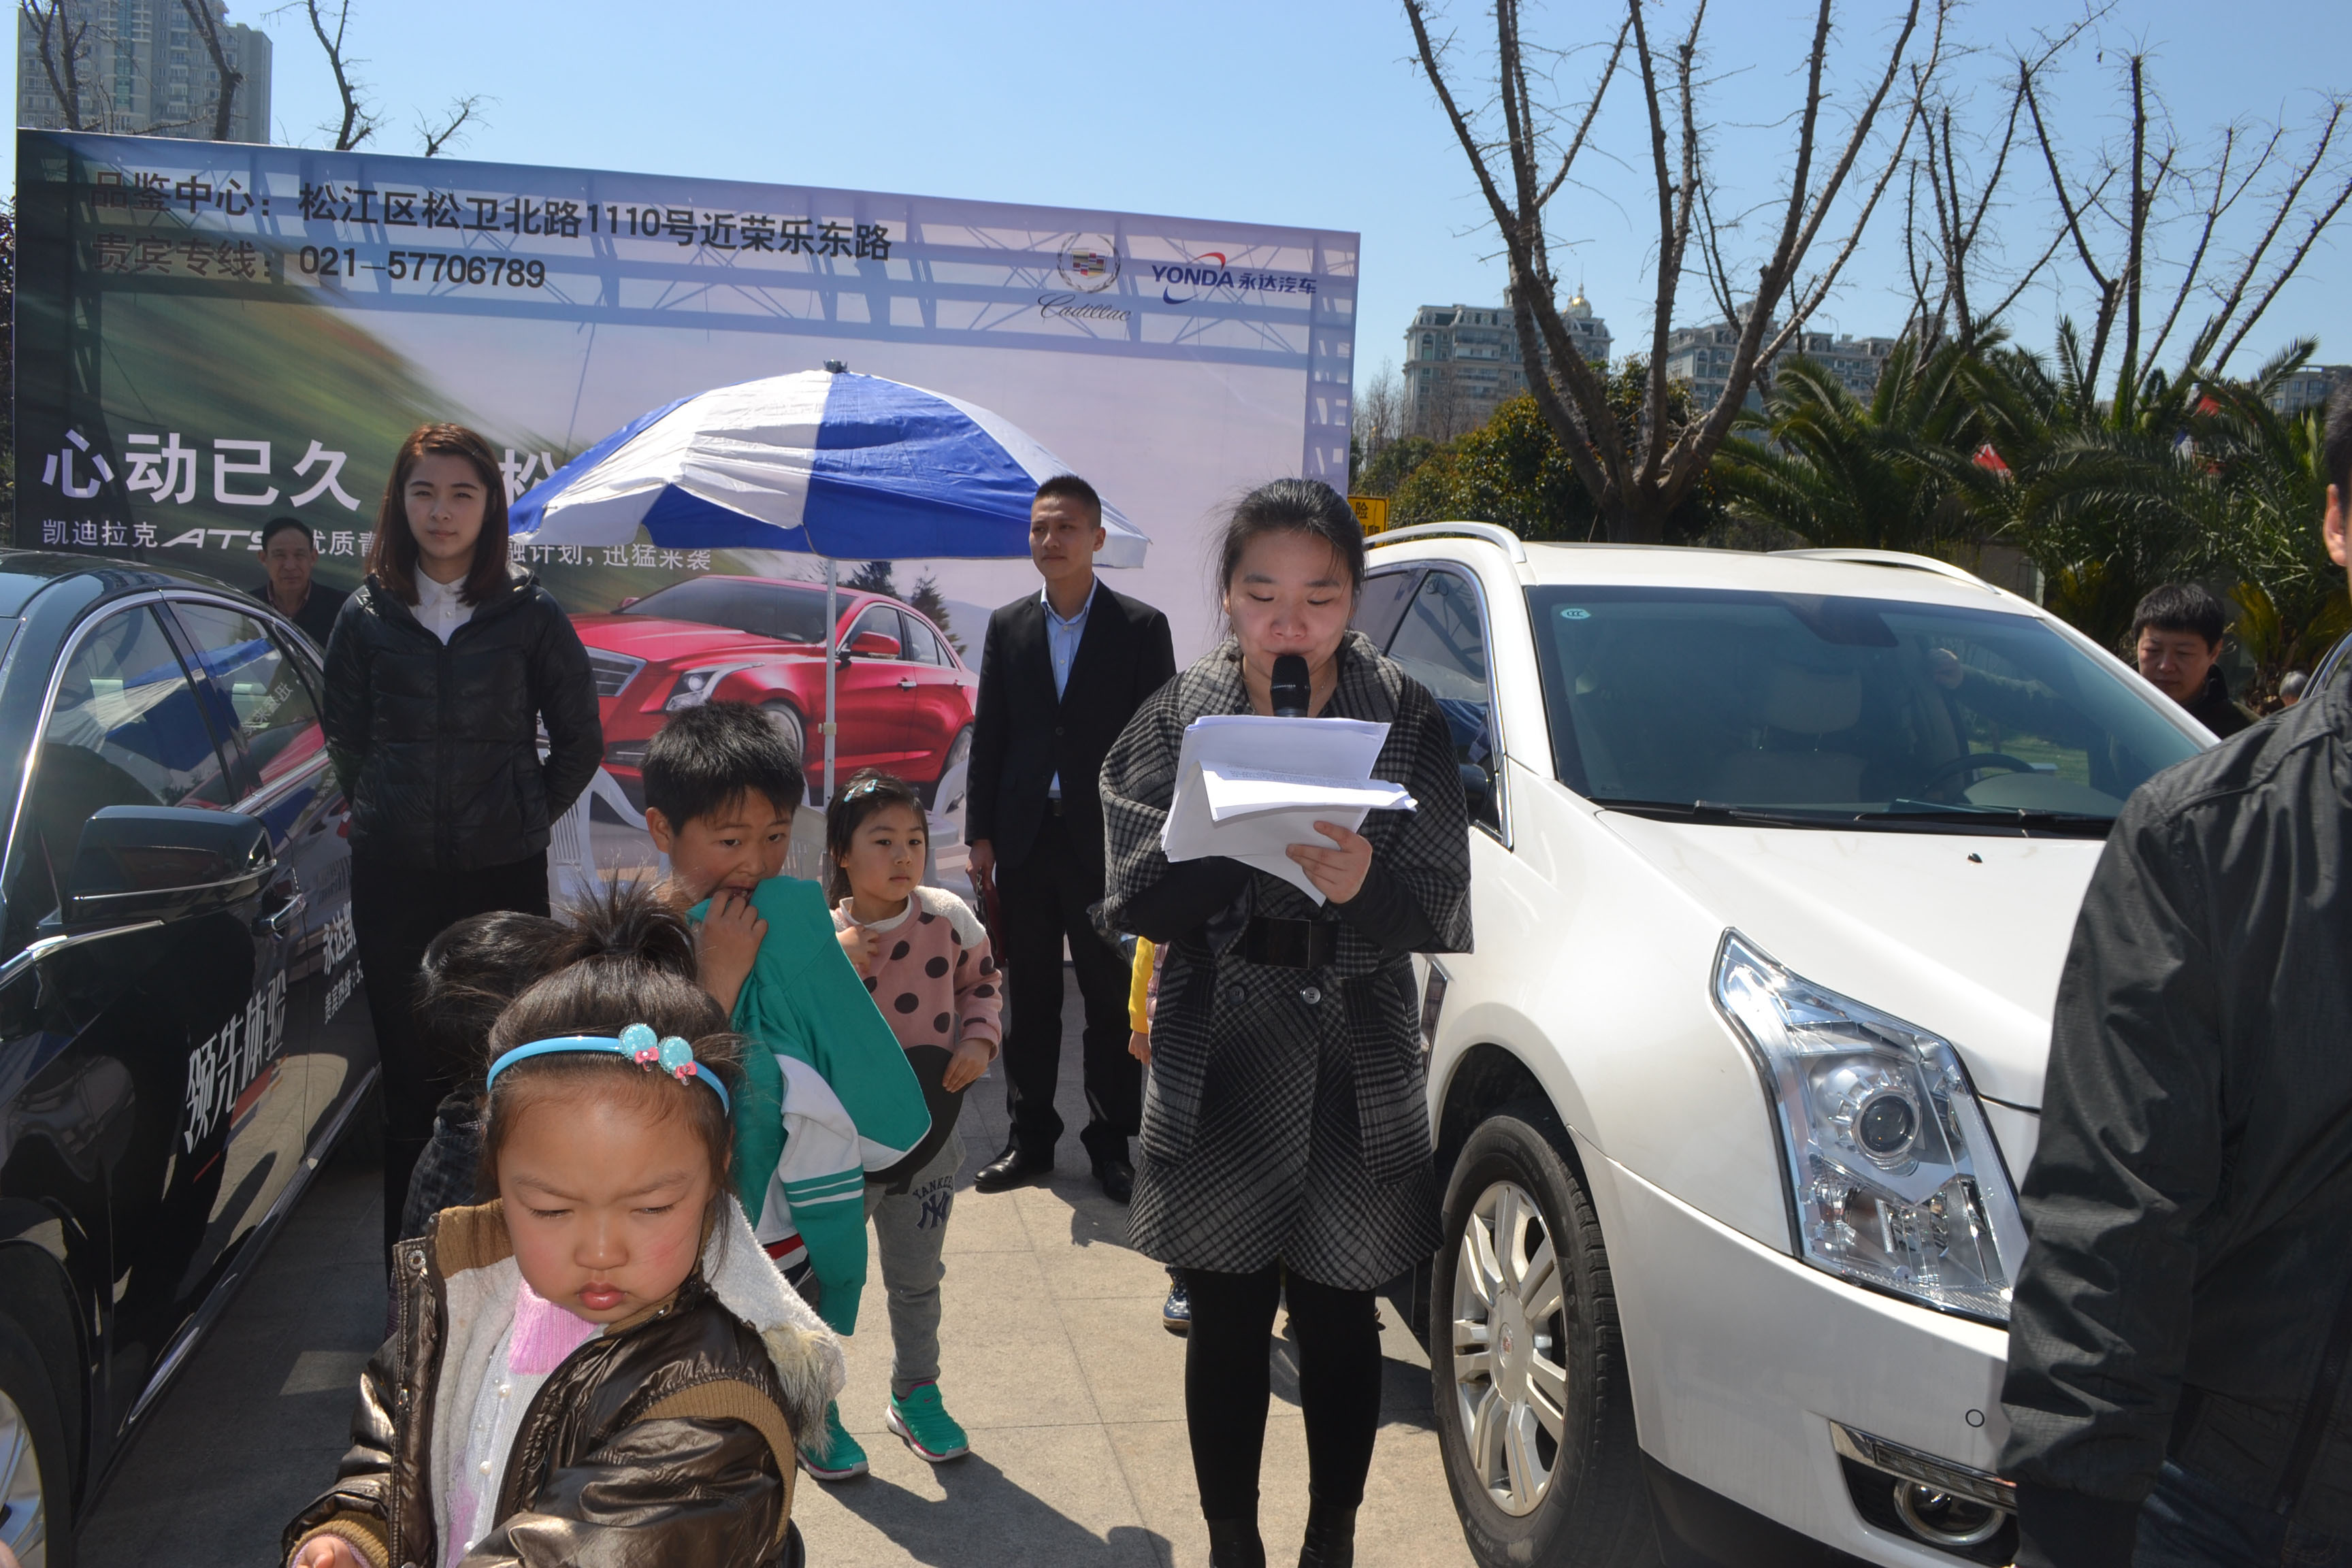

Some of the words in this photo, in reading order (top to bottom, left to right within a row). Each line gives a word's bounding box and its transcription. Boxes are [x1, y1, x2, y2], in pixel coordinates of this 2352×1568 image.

[1152, 265, 1234, 289] YONDA
[1238, 273, 1317, 295] 永达汽车
[1038, 293, 1132, 322] Cadillac
[42, 428, 361, 511] 心动已久
[42, 520, 159, 548] 凯迪拉克
